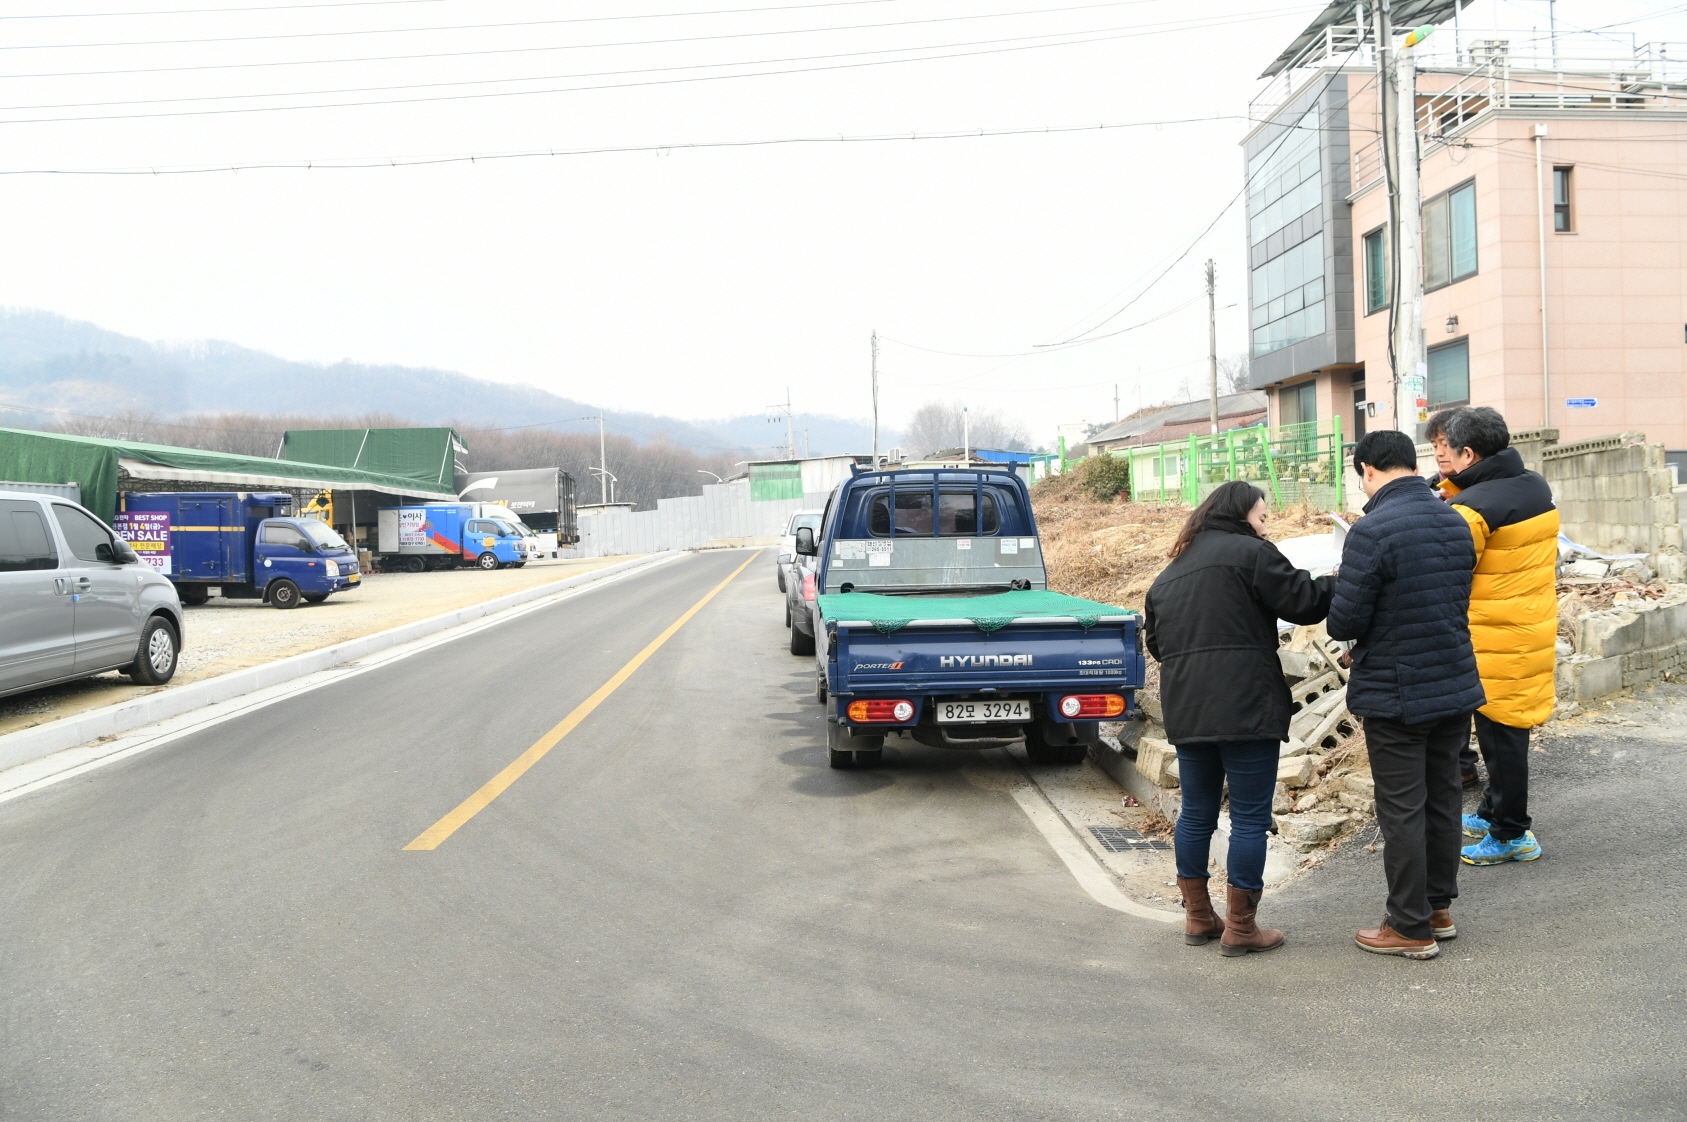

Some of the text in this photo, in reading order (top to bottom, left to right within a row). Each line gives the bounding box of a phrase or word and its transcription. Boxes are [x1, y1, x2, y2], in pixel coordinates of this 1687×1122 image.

[137, 531, 168, 540] SALE
[143, 558, 164, 566] 733
[940, 654, 1033, 668] HYUNDAI
[946, 703, 1022, 719] 82모 3294
